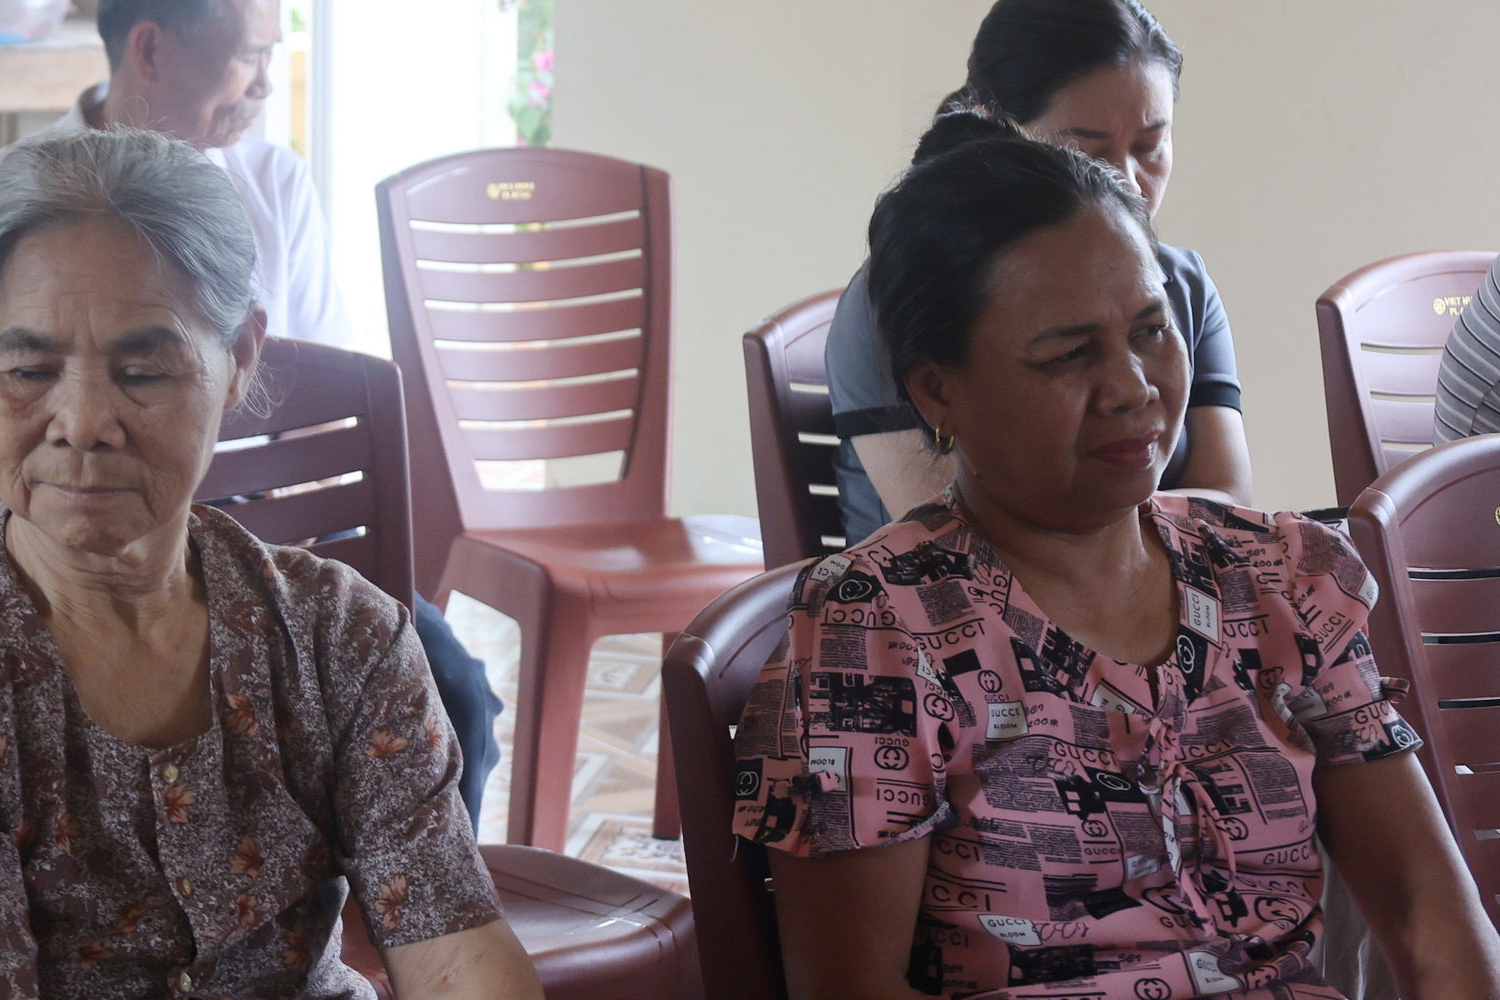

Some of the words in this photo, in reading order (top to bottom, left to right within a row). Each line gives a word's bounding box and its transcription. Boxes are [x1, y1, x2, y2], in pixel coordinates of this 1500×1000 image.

[824, 607, 897, 627] GUCCI
[1191, 592, 1201, 627] GUCCI
[914, 621, 985, 651] GUCCI
[1223, 619, 1269, 638] UCCI
[1313, 611, 1346, 644] GUCCI
[991, 707, 1020, 718] GUCCI
[1354, 700, 1390, 726] GUC
[875, 737, 910, 747] GUCCI
[1175, 739, 1231, 761] UCCI
[1053, 741, 1119, 767] GUCCI
[876, 787, 931, 807] GUCCI
[1083, 847, 1121, 856] GUCC
[1263, 844, 1310, 865] GUCC
[987, 918, 1027, 928] GUCCI
